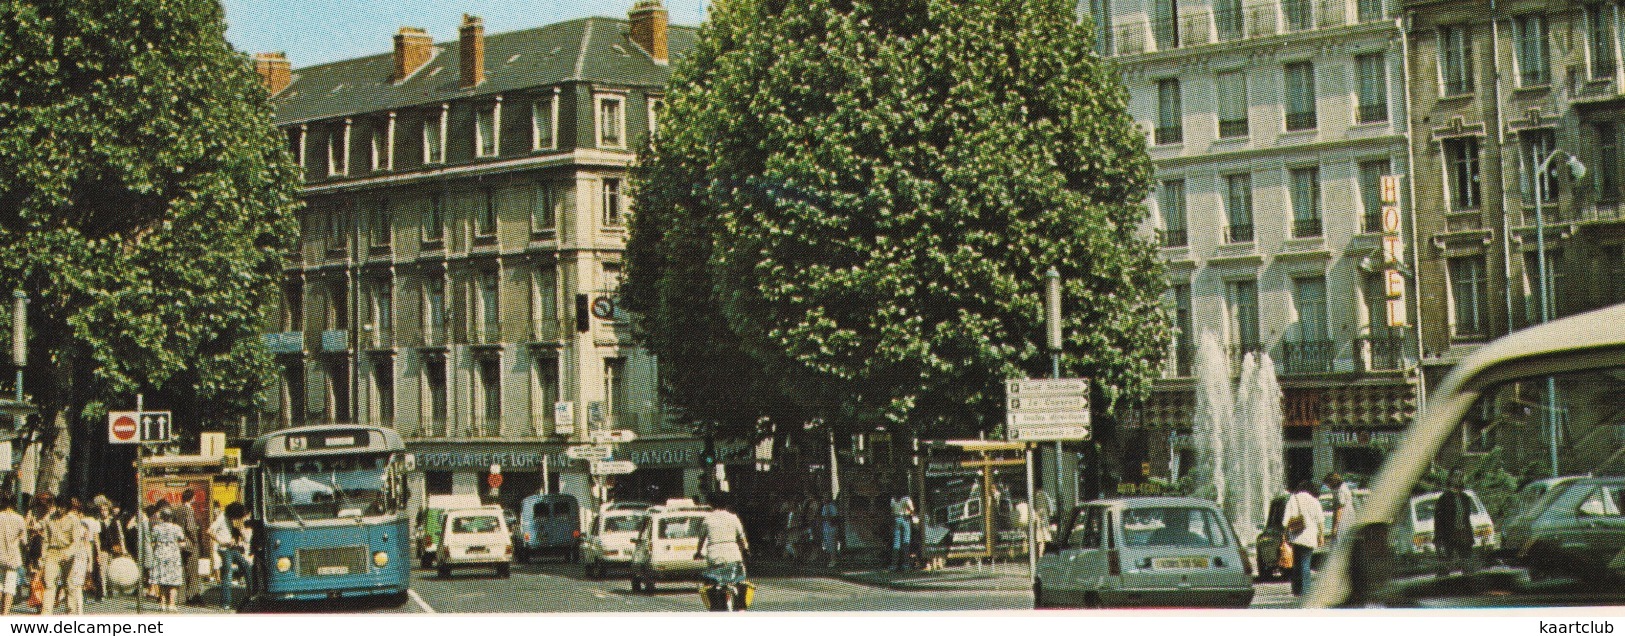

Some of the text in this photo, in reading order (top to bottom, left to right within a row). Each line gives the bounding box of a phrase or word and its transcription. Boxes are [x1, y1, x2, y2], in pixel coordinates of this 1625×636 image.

[1383, 175, 1404, 327] HOTEL
[424, 453, 490, 467] POPULAIRE
[492, 452, 509, 467] DE
[511, 452, 573, 467] LORAINE
[630, 448, 693, 465] BANQUE
